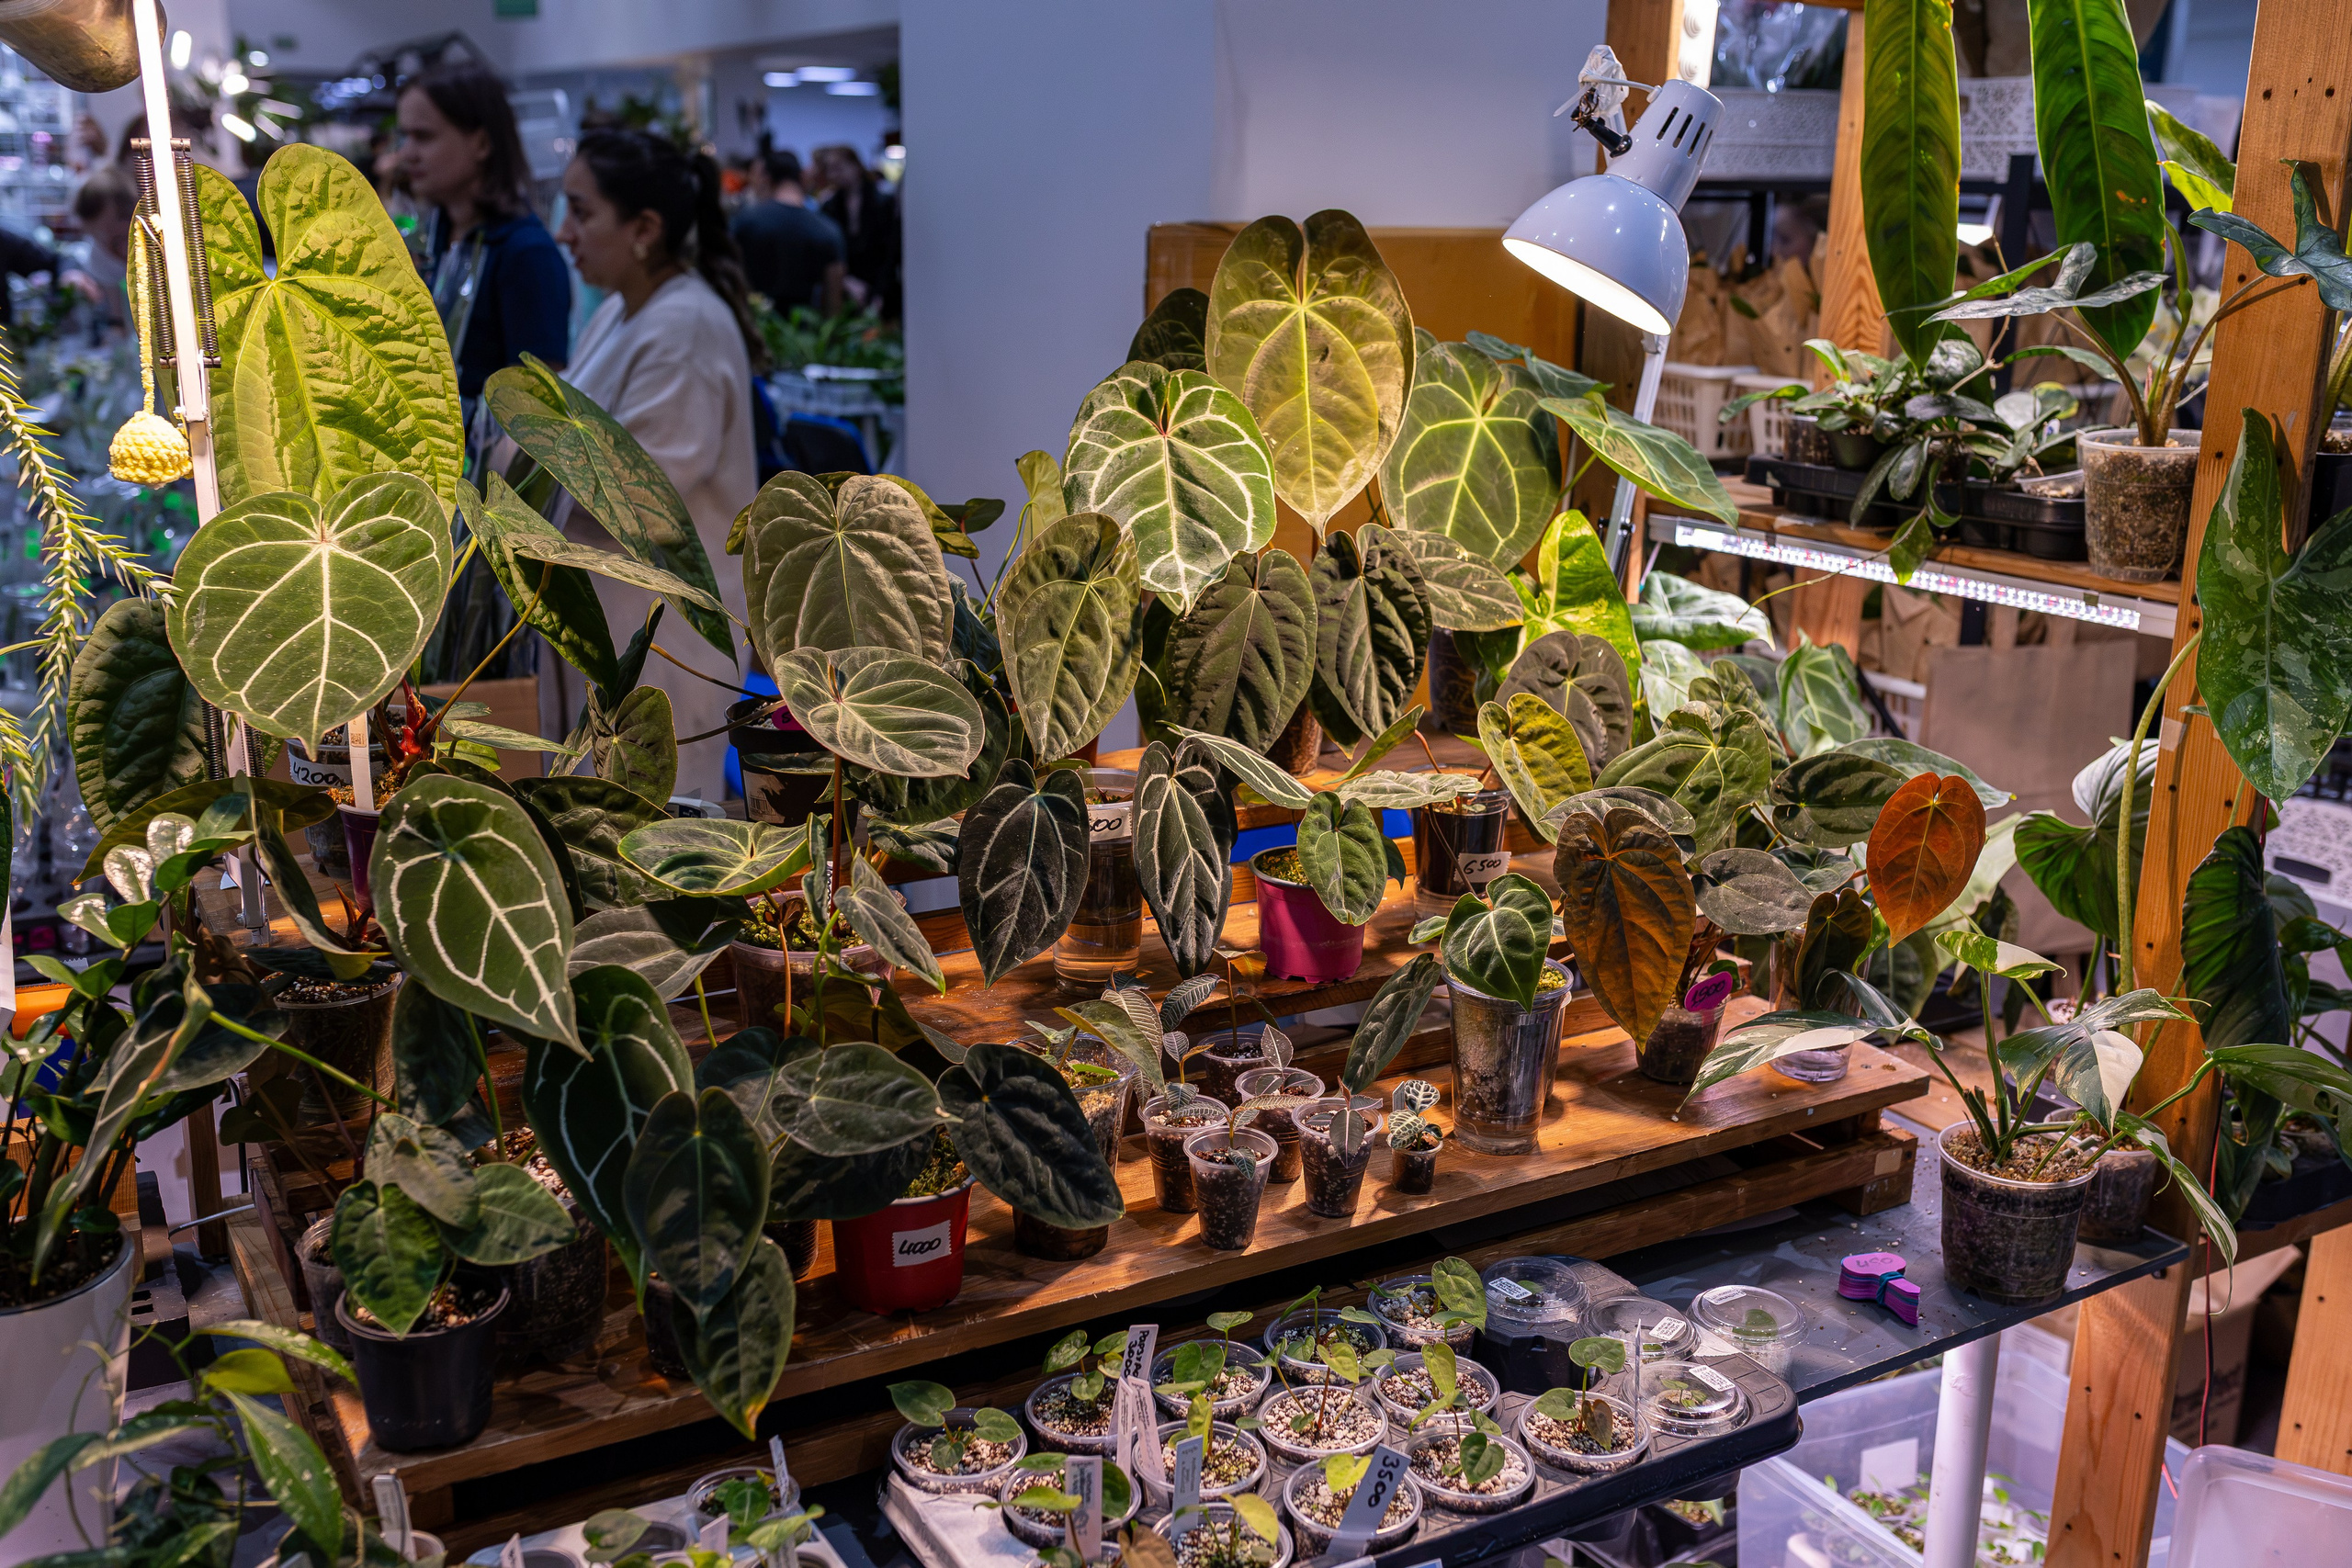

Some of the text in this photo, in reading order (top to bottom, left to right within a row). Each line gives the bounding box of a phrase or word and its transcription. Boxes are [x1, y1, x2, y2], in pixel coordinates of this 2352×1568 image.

[292, 761, 340, 786] 4200
[898, 1237, 942, 1256] 4000
[1367, 1454, 1400, 1508] 3500
